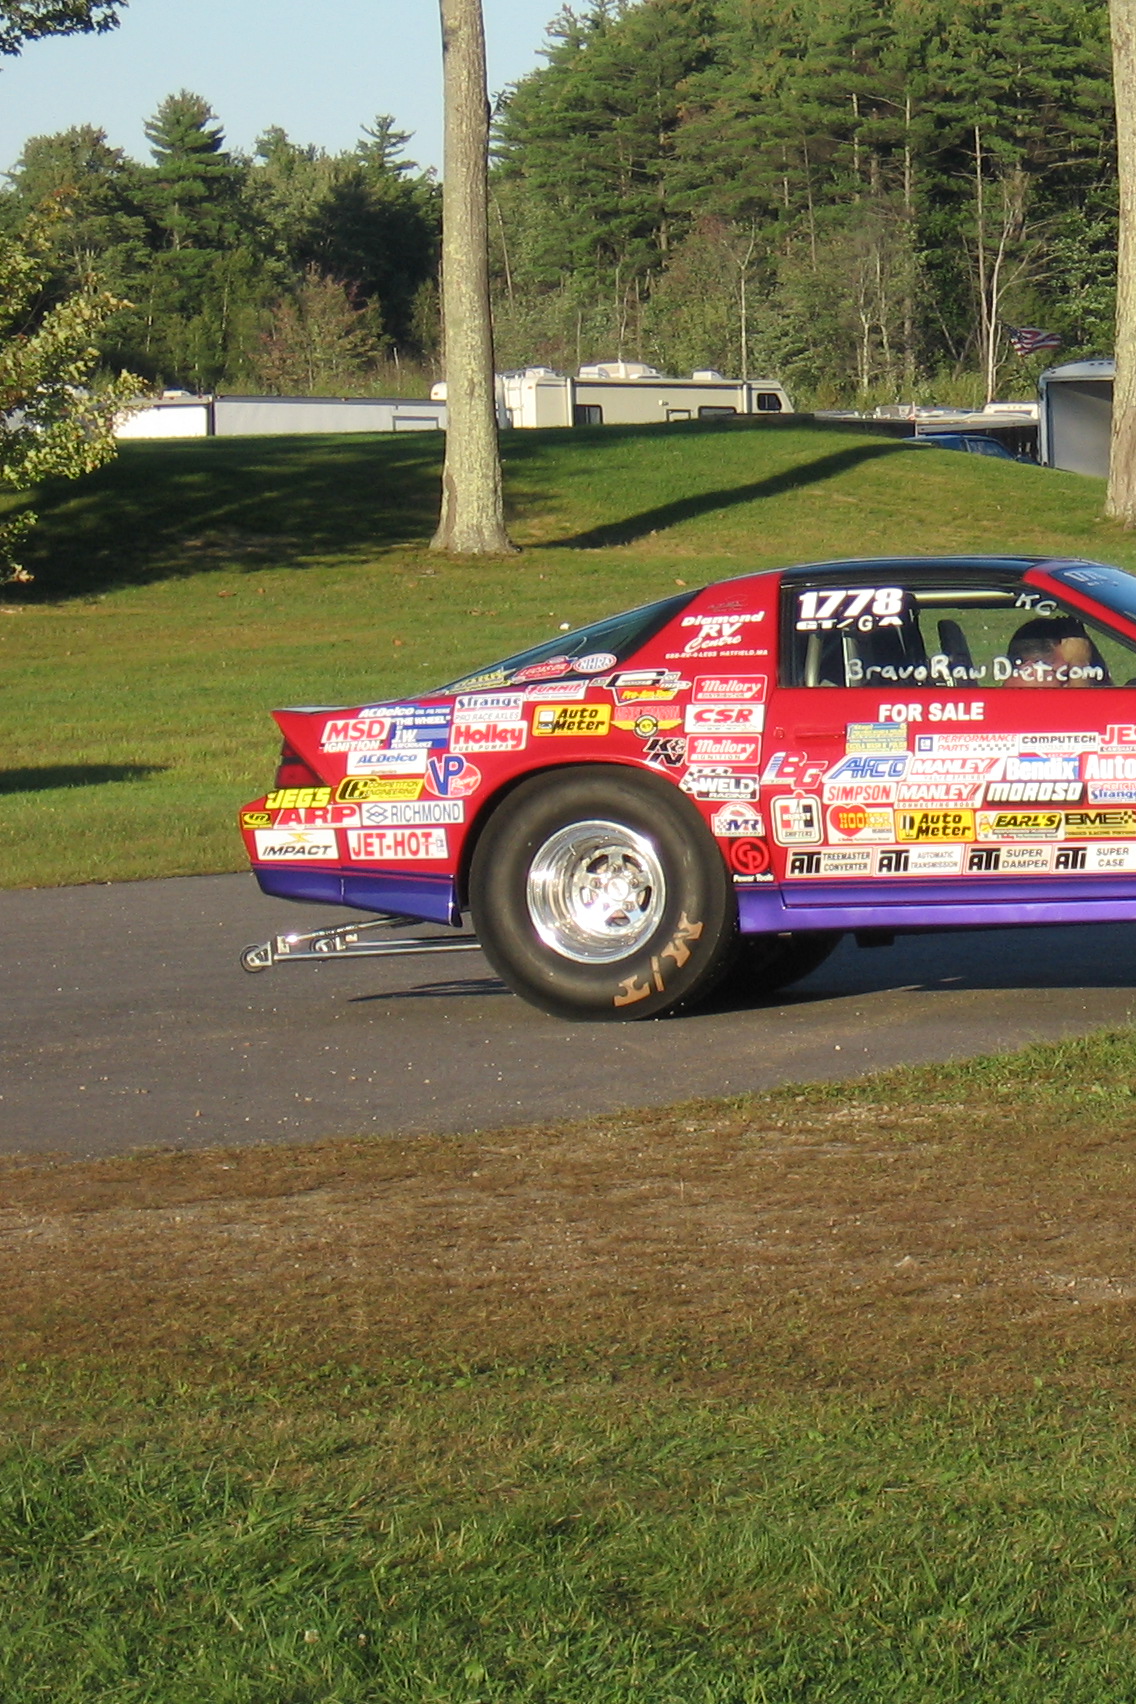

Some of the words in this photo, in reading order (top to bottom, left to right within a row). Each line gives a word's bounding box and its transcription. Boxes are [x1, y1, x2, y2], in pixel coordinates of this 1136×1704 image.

[799, 588, 903, 619] 1778
[681, 611, 765, 626] Diamond
[699, 623, 743, 638] RV
[702, 680, 761, 692] Mallory
[558, 708, 598, 719] Auto
[693, 709, 753, 722] CSR
[879, 704, 923, 722] FOR
[928, 702, 984, 721] SALE
[326, 719, 385, 741] MSD
[552, 720, 605, 734] Meter
[454, 724, 523, 749] Holley
[938, 734, 1017, 742] PERFORMANCE
[1022, 735, 1097, 744] COMPUTECH
[694, 740, 756, 753] Mallory
[357, 754, 417, 764] ACDelco
[911, 758, 991, 774] MANLEY
[429, 755, 464, 796] VP
[700, 778, 753, 792] WELD
[897, 782, 981, 802] MANLEY
[828, 785, 891, 801] SIMPSON
[276, 806, 357, 826] ARP
[390, 803, 461, 823] RICHMOND
[920, 813, 962, 824] Auto
[1065, 812, 1122, 825] BME
[995, 815, 1057, 828] EARL'S
[914, 825, 971, 838] Meter
[262, 846, 333, 856] IMPACT
[352, 832, 432, 857] JET-HOT
[823, 852, 870, 860] TREEMASTER
[1006, 850, 1042, 858] SUPER
[1055, 847, 1087, 870] ATI
[1097, 848, 1130, 856] SUPER
[790, 850, 822, 874] ATI
[878, 850, 910, 873] ATI
[968, 848, 1000, 871] ATI
[1002, 860, 1048, 868] DAMPER
[1098, 859, 1124, 867] CASE
